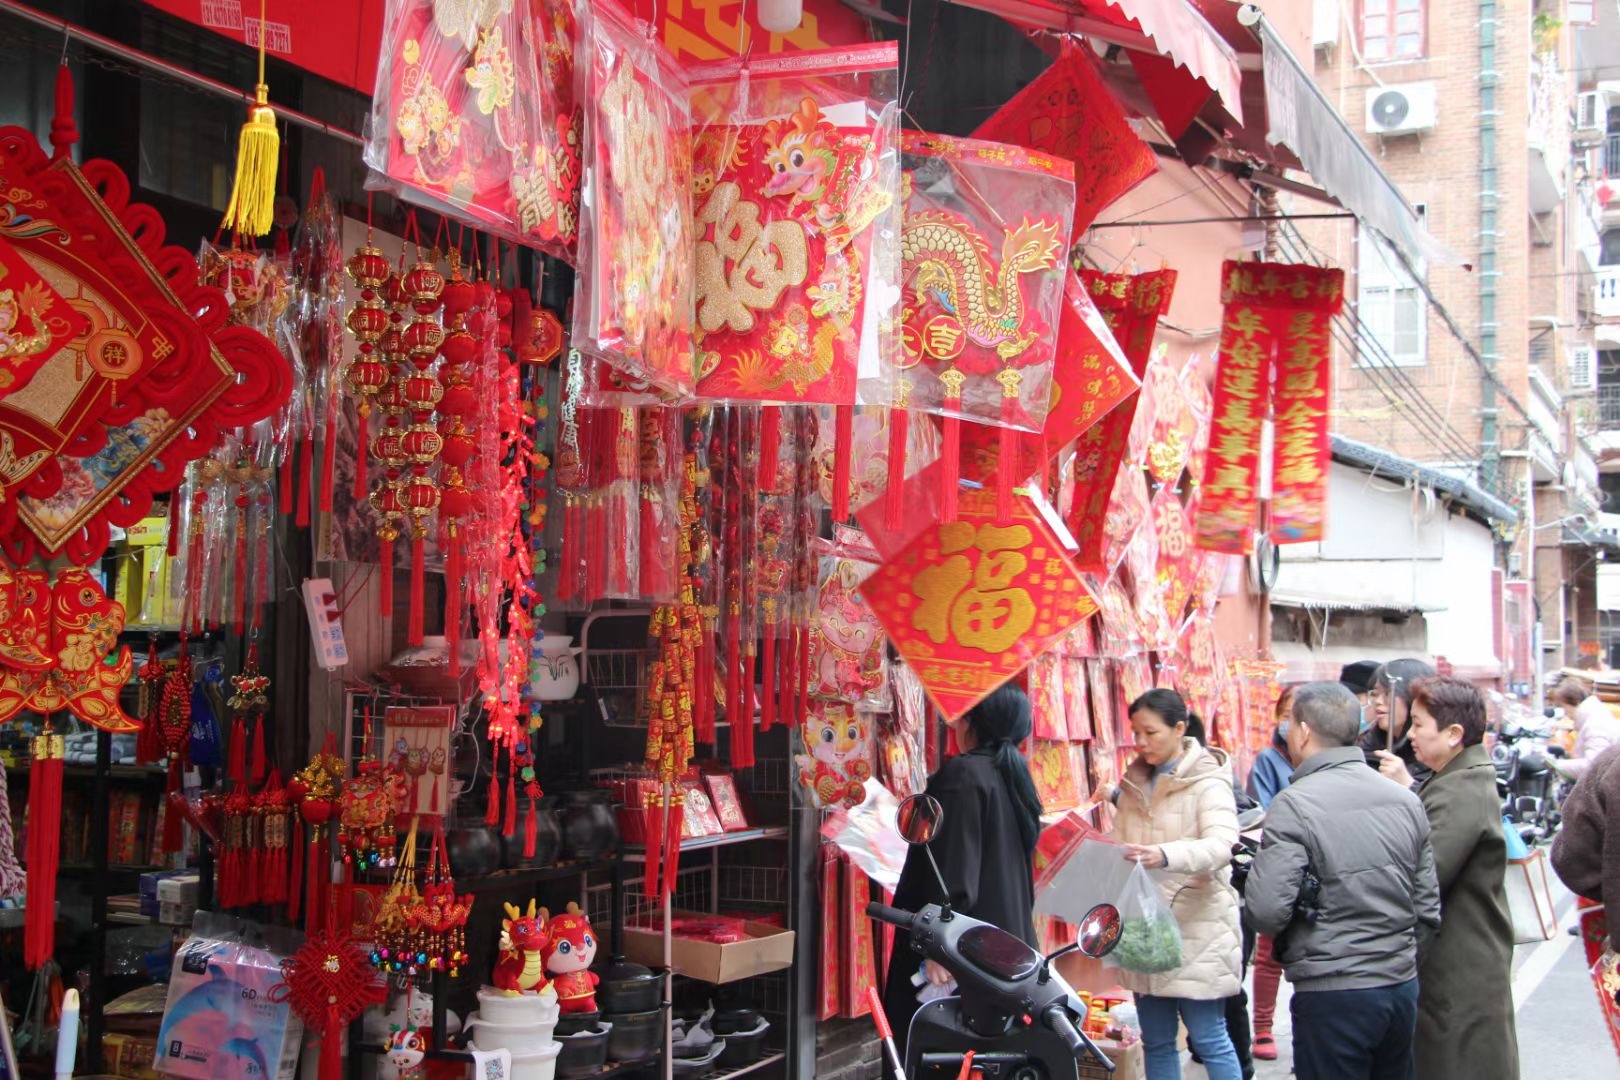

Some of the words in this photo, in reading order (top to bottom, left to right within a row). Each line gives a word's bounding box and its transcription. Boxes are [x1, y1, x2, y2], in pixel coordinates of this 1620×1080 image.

[692, 181, 808, 333] 福
[104, 346, 125, 364] 祥
[1155, 503, 1186, 557] 福
[911, 520, 1036, 653] 福
[58, 633, 95, 671] 福
